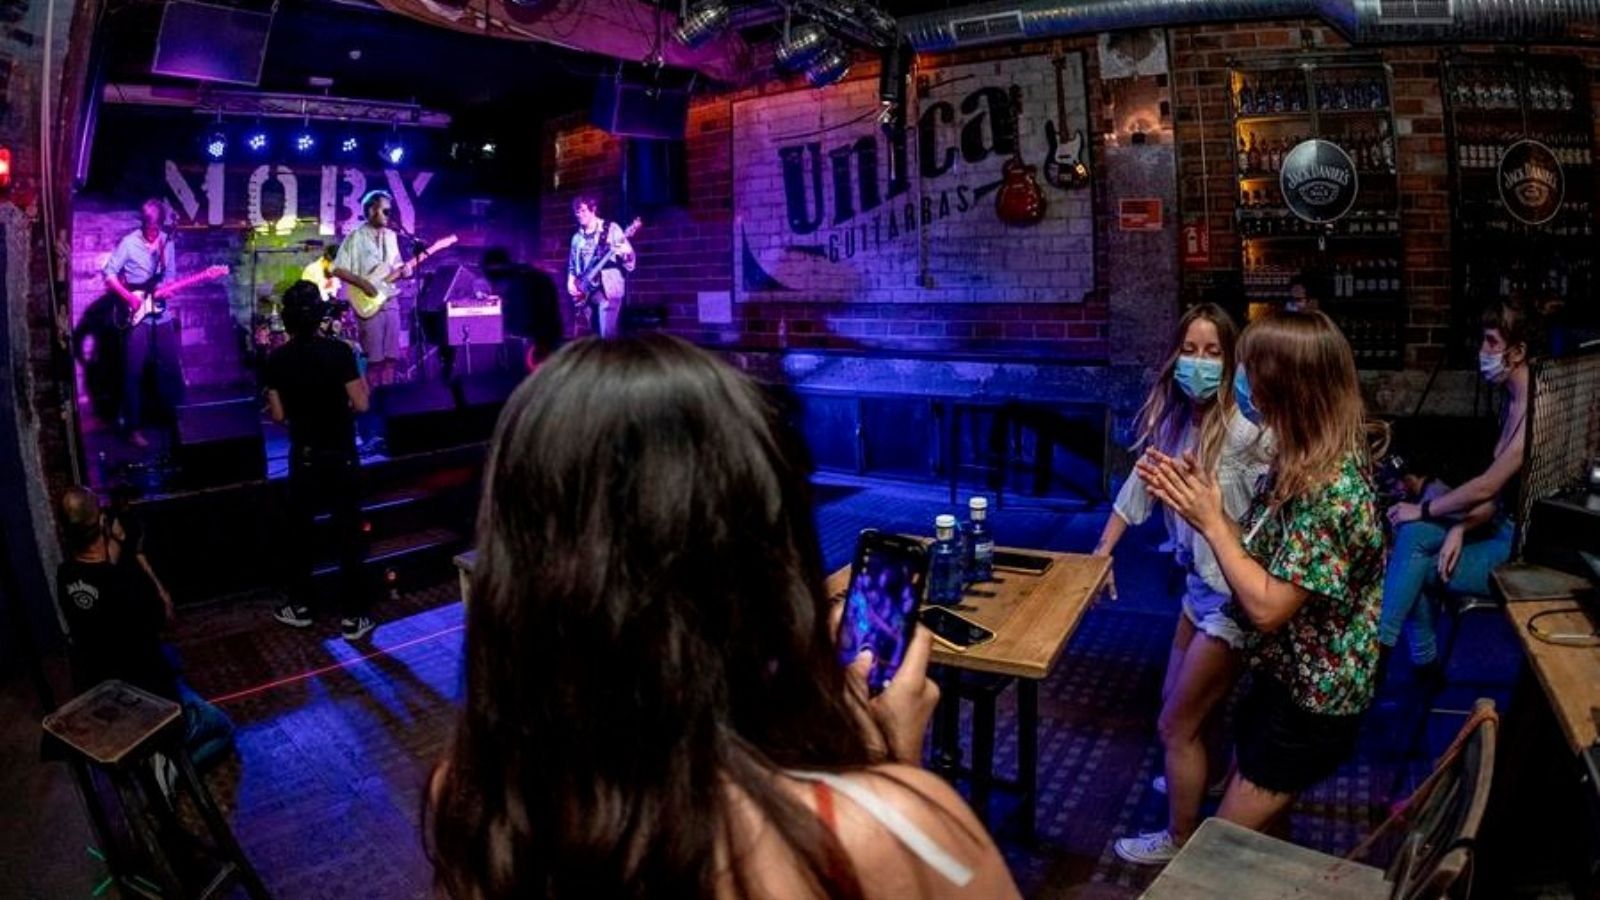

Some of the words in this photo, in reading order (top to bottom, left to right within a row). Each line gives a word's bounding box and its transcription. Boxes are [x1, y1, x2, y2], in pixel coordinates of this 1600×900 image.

[165, 160, 434, 236] MOBY
[777, 86, 1015, 235] Unica
[828, 185, 969, 263] GUITARRAS
